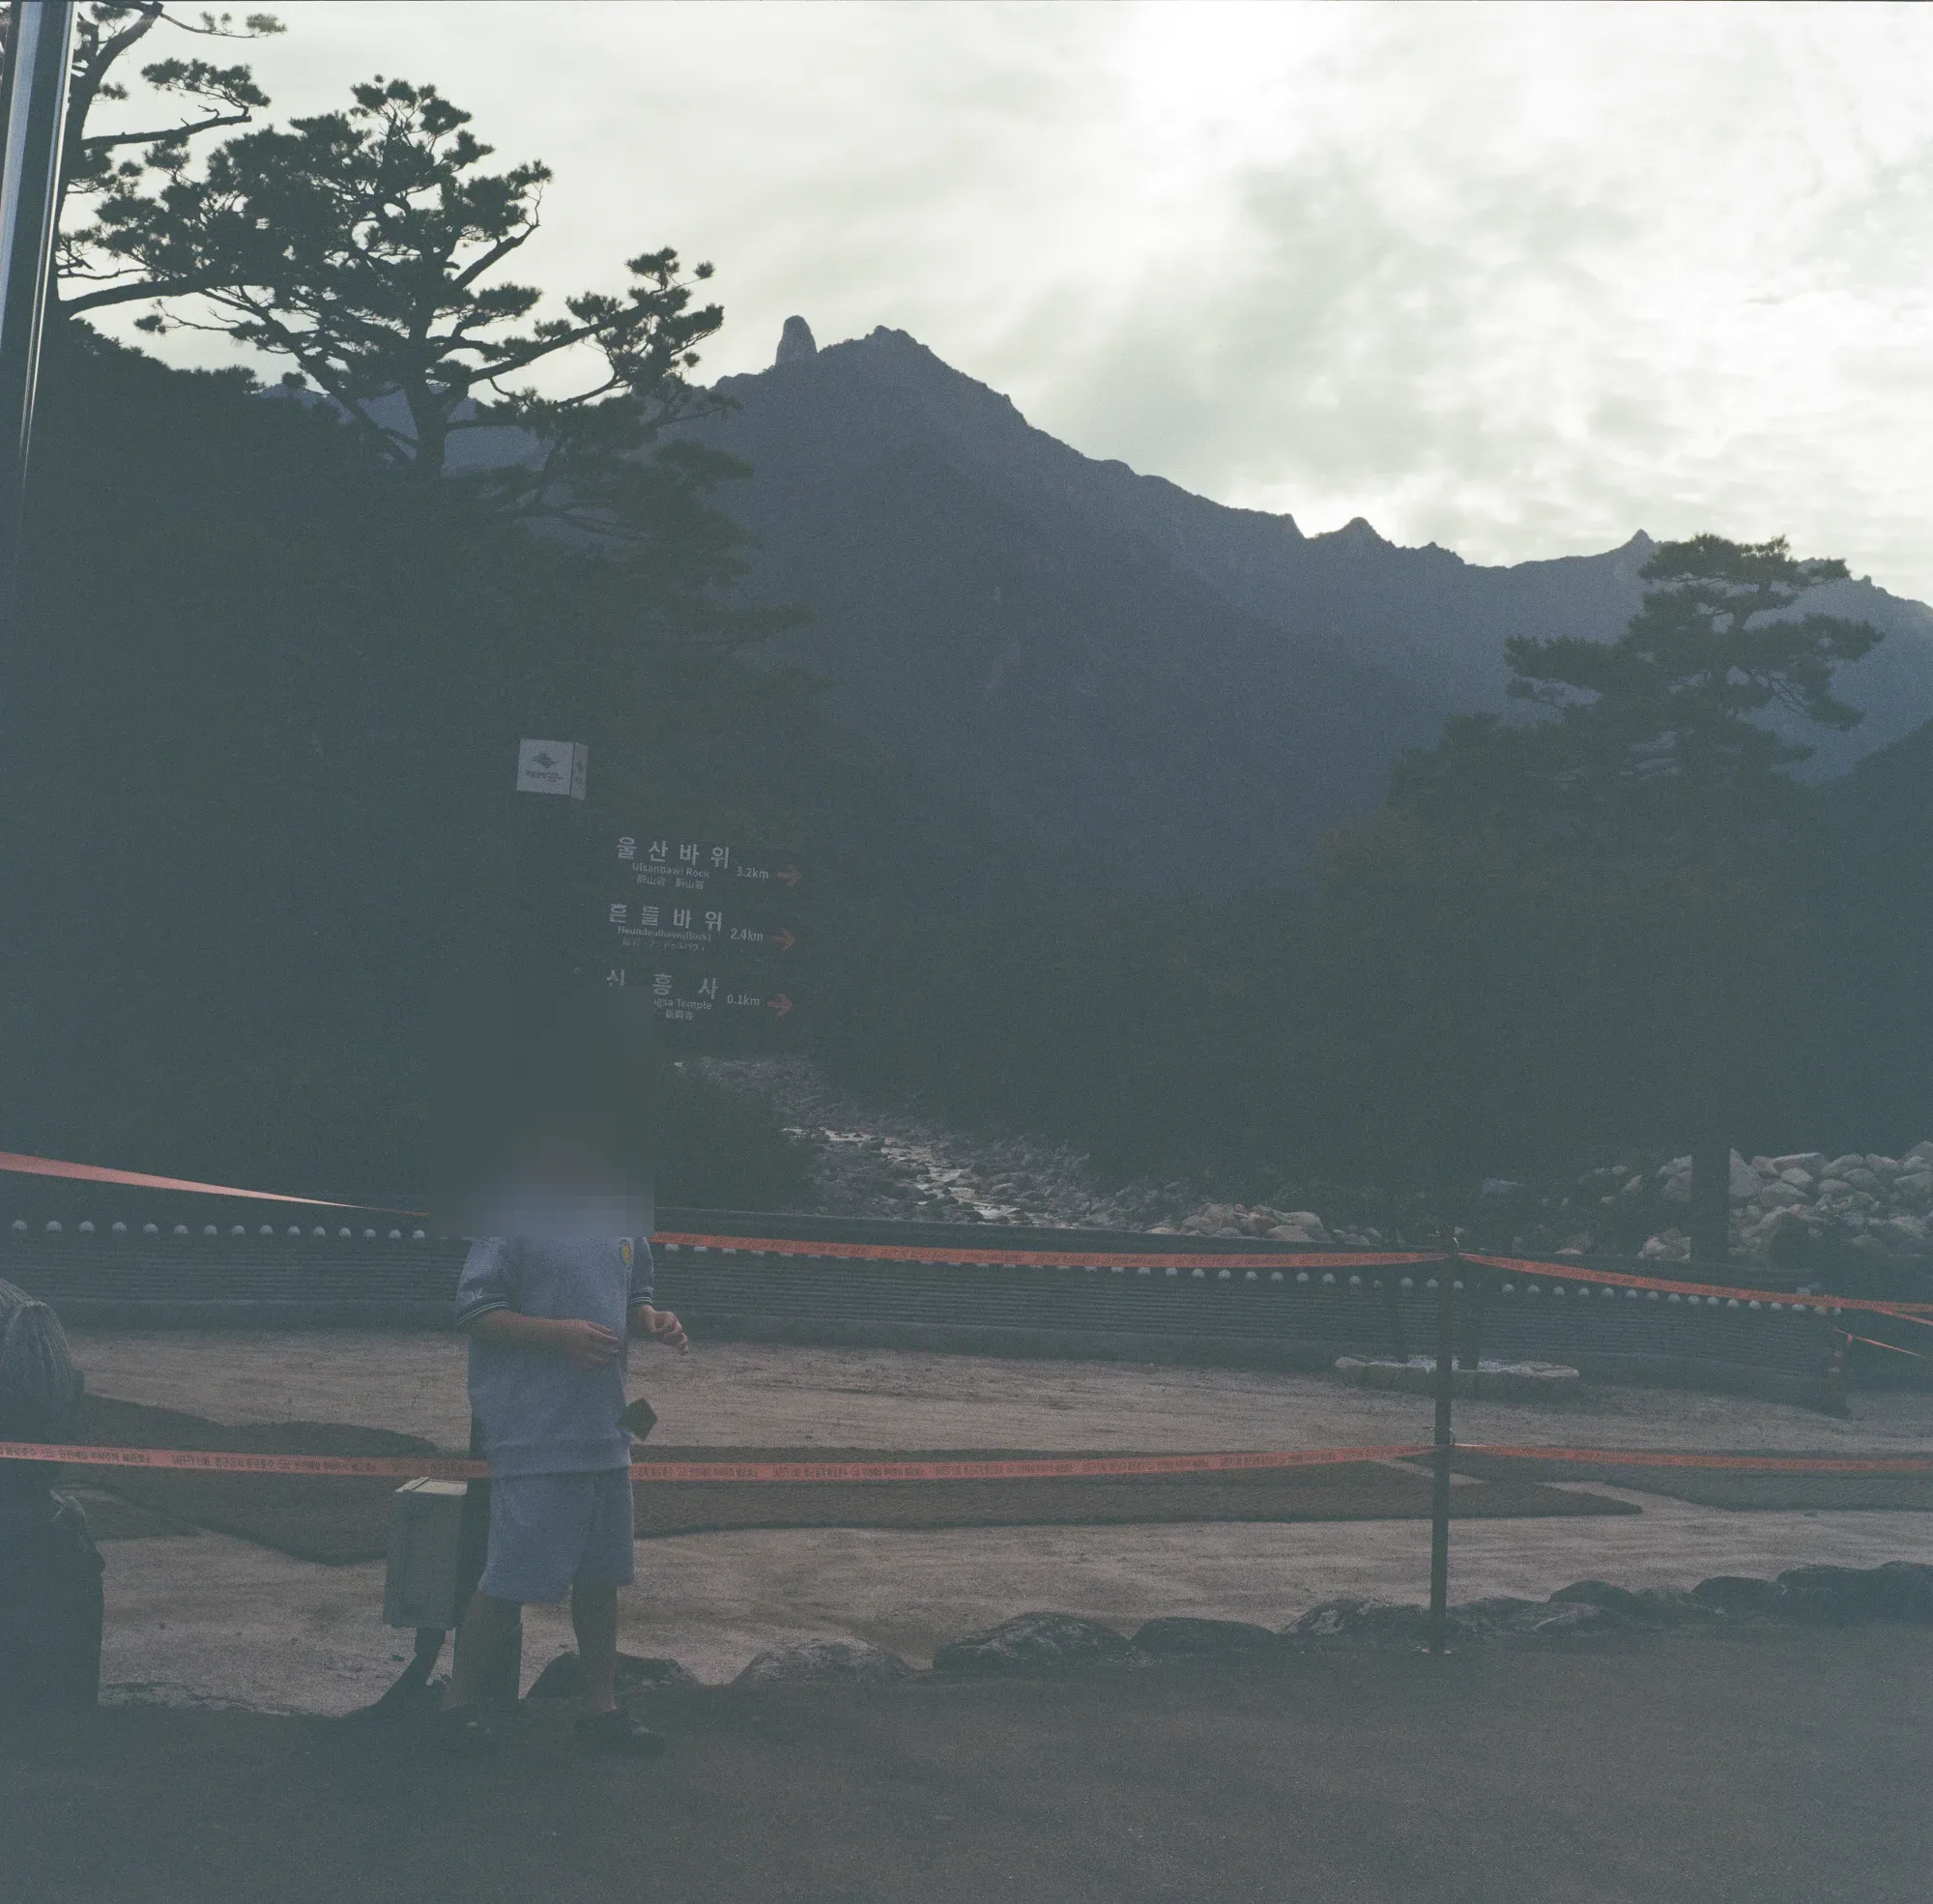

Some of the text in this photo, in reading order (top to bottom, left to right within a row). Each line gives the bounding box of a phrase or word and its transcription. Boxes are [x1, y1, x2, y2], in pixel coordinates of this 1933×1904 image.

[617, 836, 730, 869] 울산바위
[632, 861, 710, 879] Ulsanbawi Rock
[736, 866, 769, 880] 3.2km
[609, 903, 722, 933] 흔들바위
[730, 928, 764, 942] 2.4km
[676, 998, 712, 1011] Temple
[727, 994, 761, 1007] 0.1km
